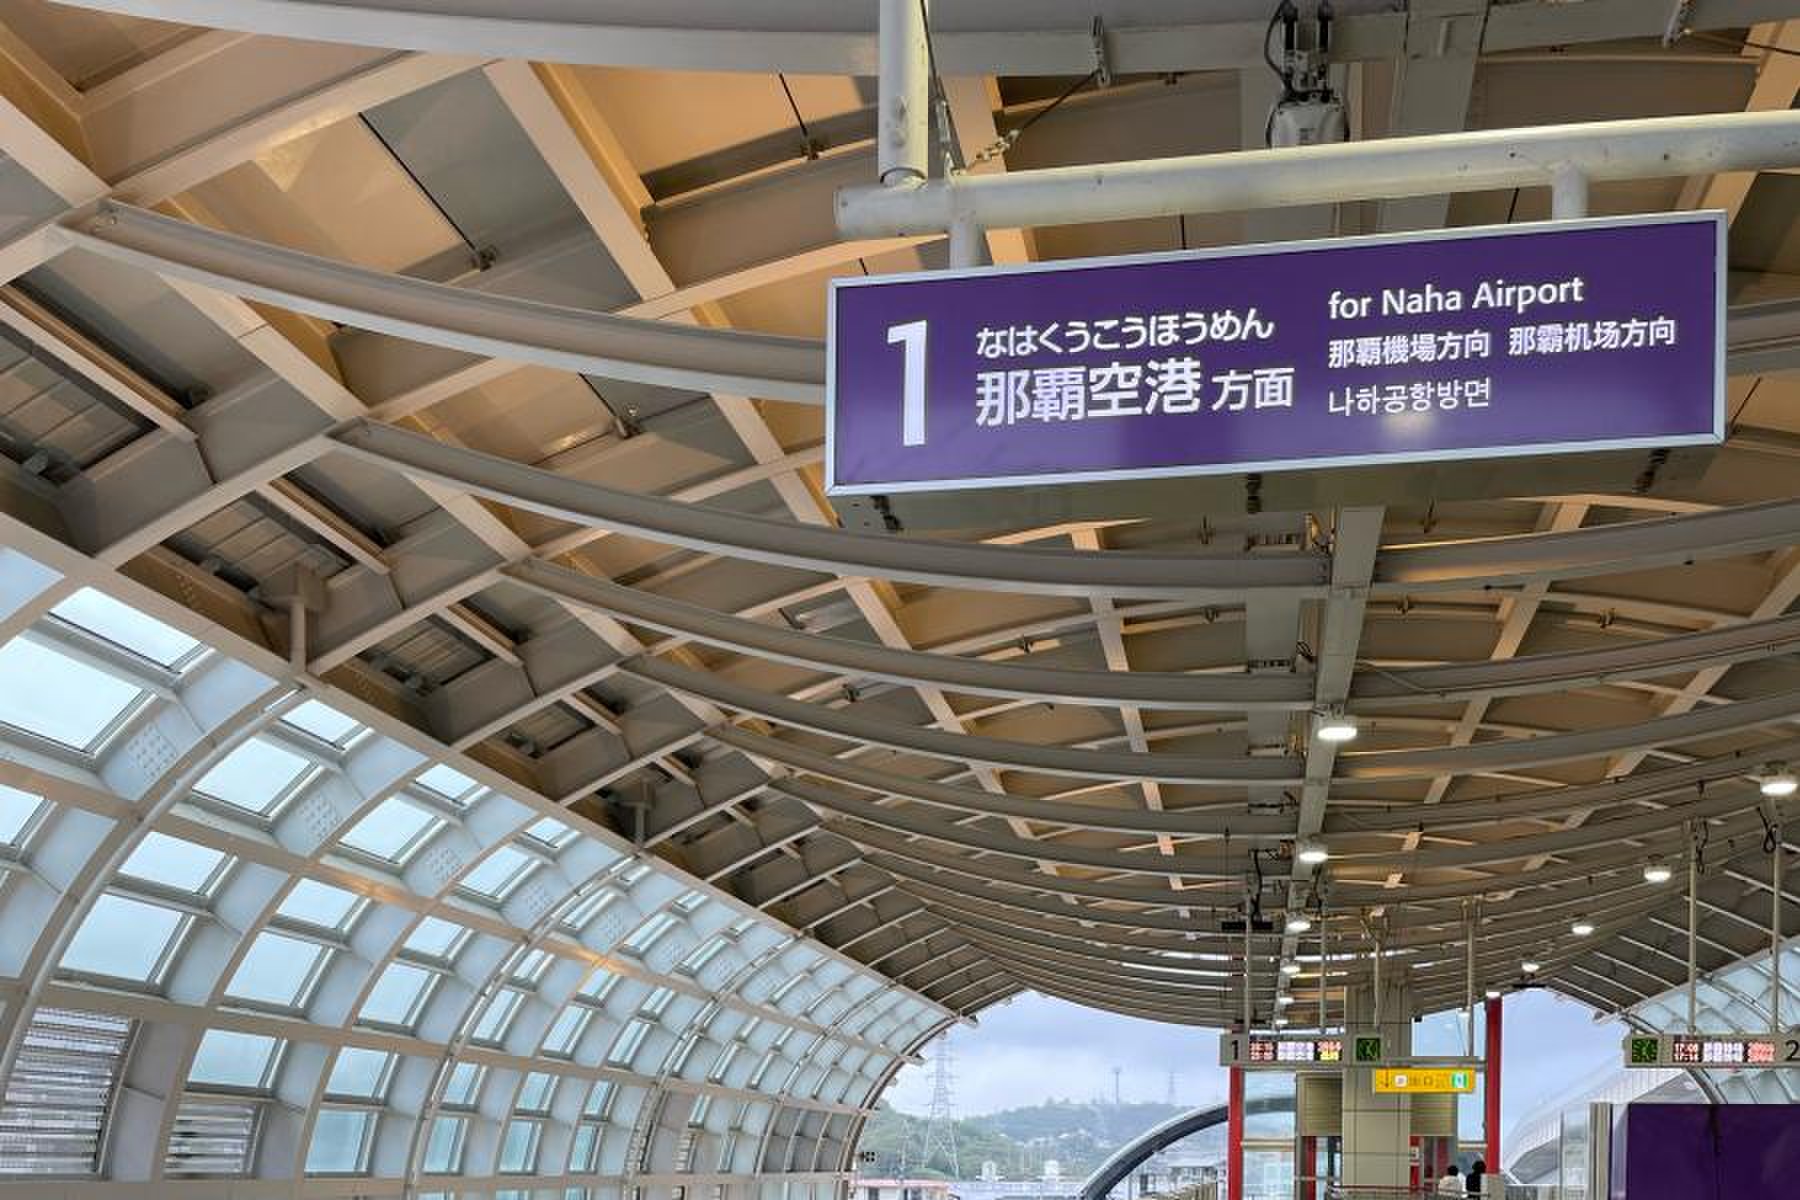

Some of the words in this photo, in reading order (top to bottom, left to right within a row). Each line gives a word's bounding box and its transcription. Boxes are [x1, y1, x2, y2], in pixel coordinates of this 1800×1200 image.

[1328, 291, 1372, 319] for
[1381, 284, 1462, 316] Naha
[1471, 277, 1584, 314] Airport
[976, 308, 1274, 358] なはくうこうほうめん
[887, 320, 927, 447] 1
[1328, 377, 1491, 417] 나하공항방면
[1785, 1039, 1800, 1061] 2
